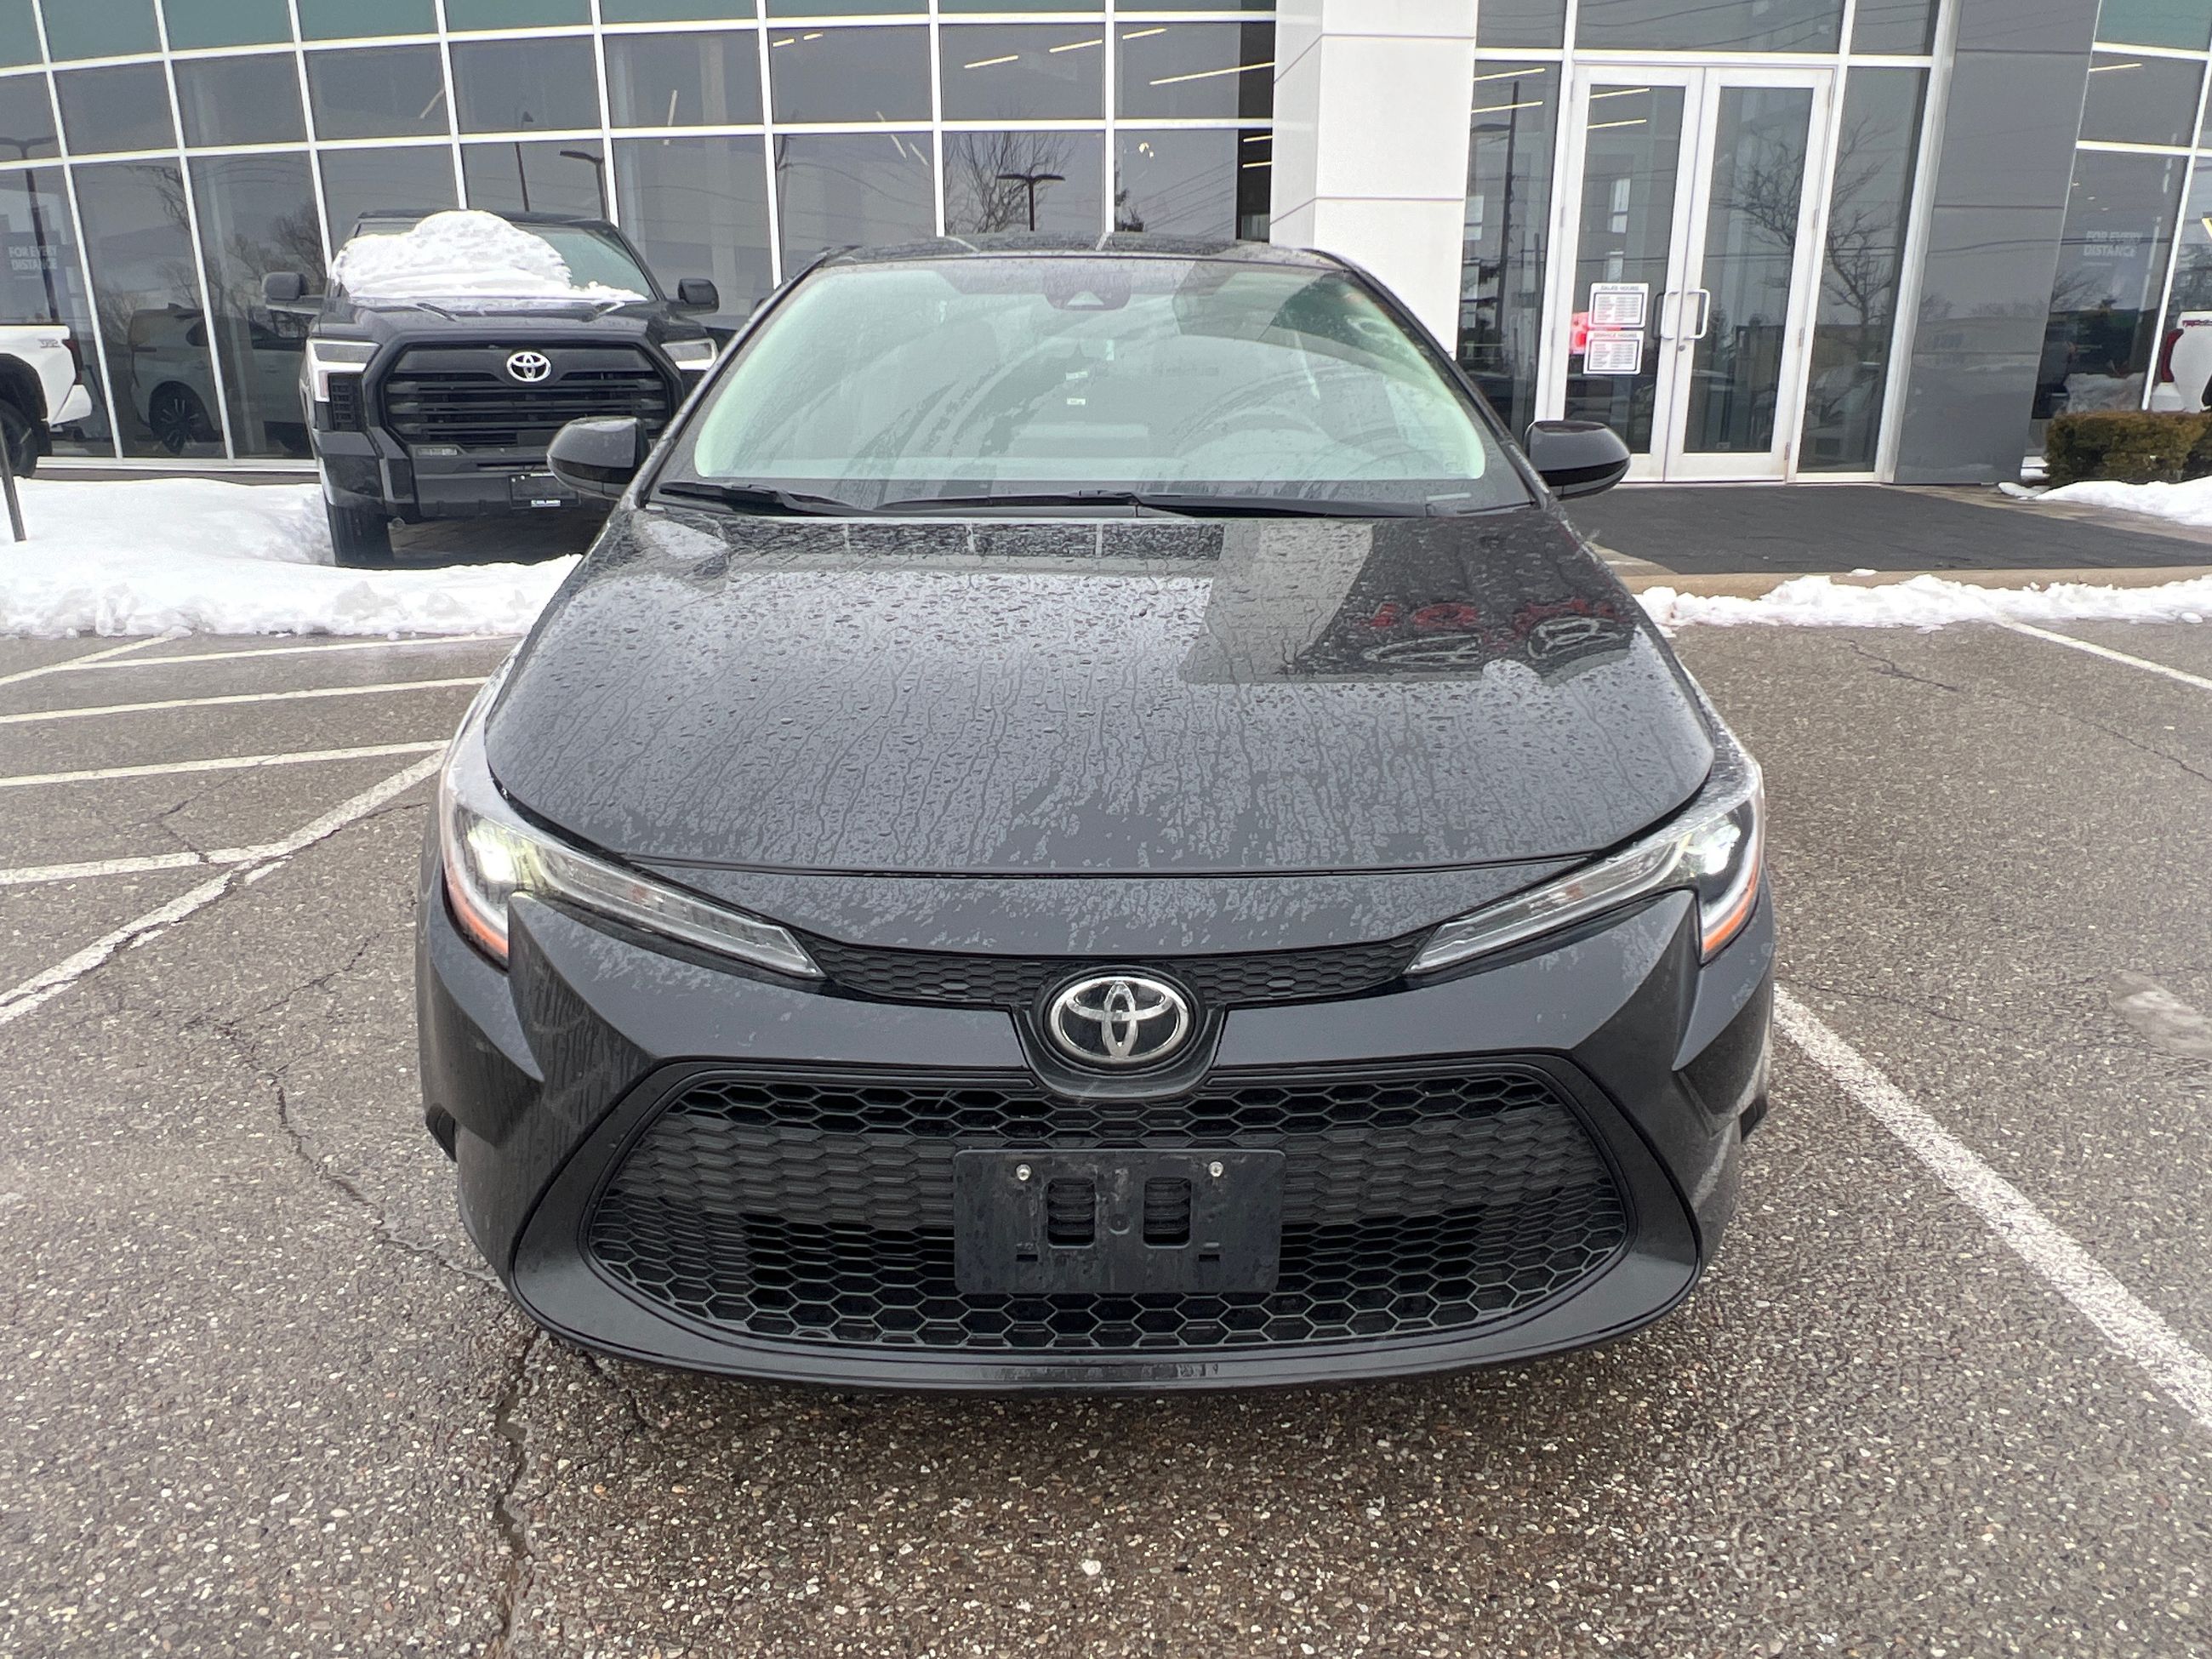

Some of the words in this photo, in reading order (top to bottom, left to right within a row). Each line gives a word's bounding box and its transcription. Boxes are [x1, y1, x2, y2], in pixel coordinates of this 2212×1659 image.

[2085, 230, 2107, 244] FOR
[9, 246, 28, 258] FOR
[28, 244, 57, 258] EVERY
[2082, 243, 2138, 258] DISTANCE
